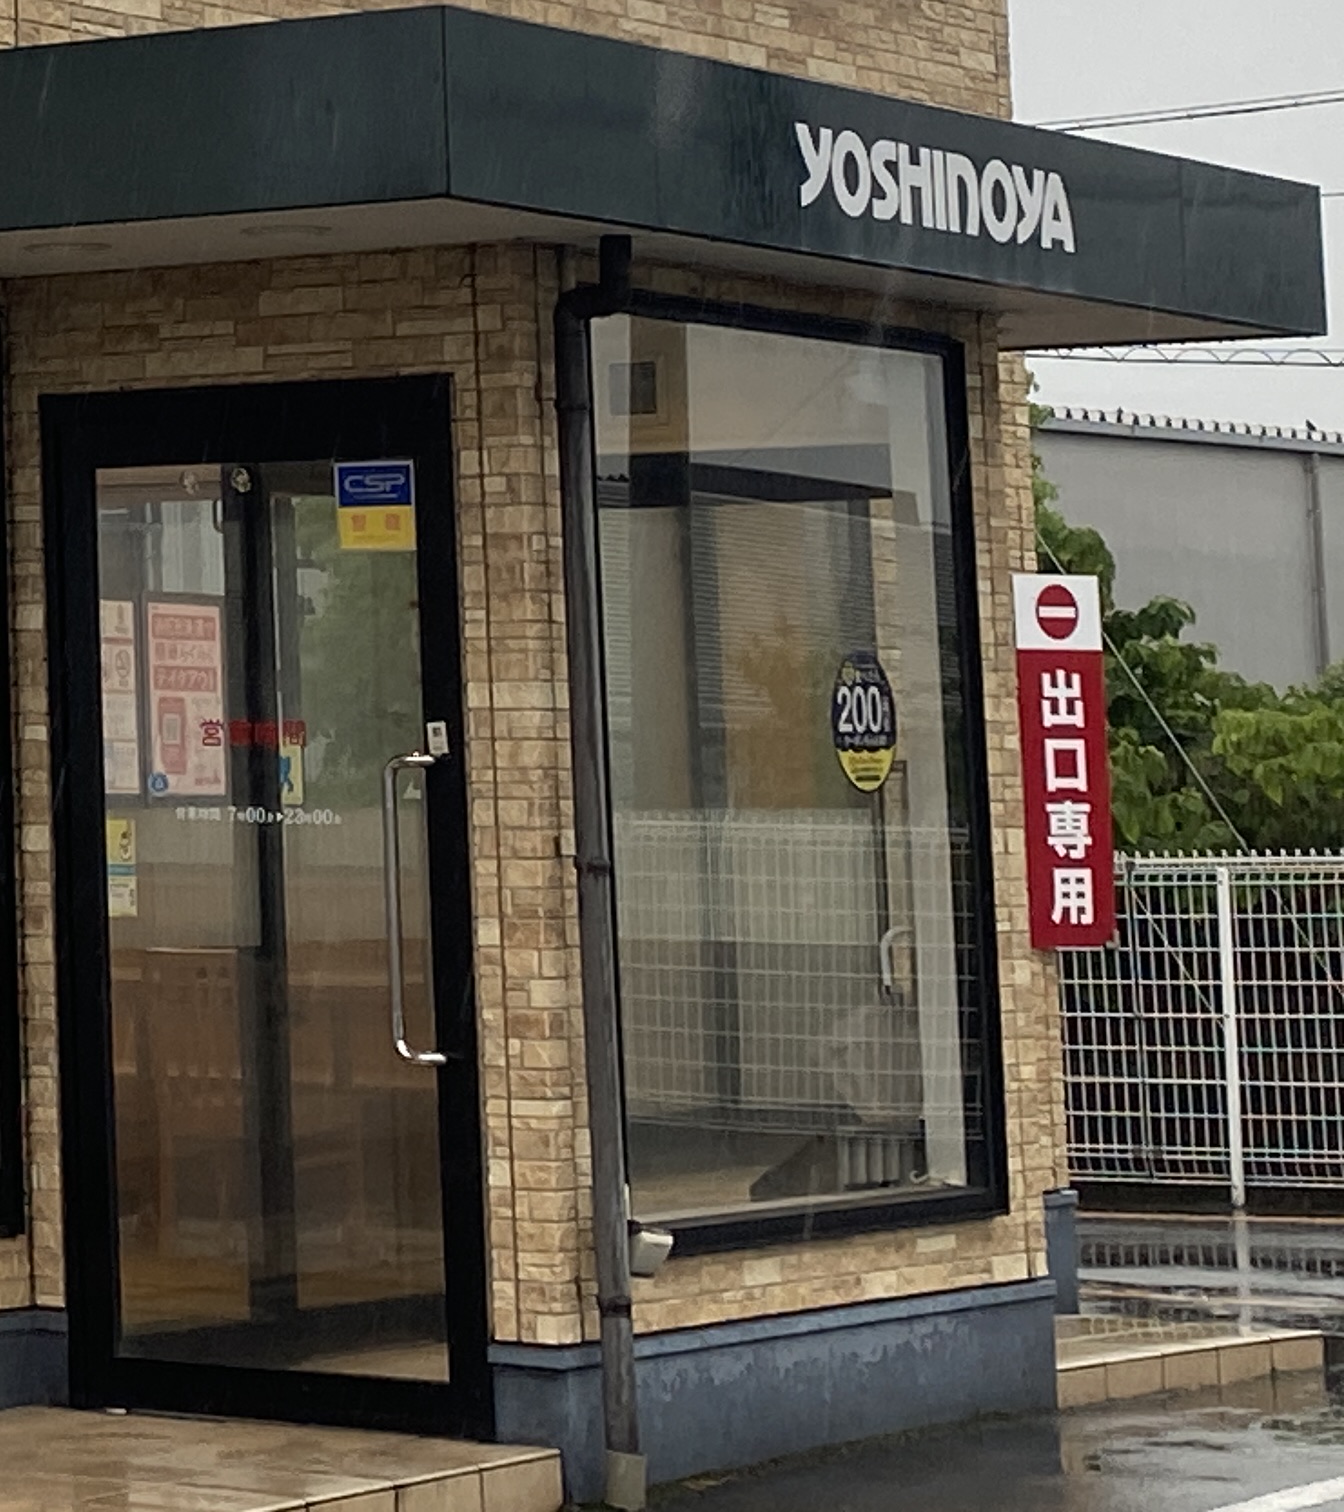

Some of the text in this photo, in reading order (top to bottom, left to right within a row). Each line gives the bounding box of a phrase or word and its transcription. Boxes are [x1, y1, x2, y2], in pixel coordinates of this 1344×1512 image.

[794, 122, 1076, 254] YOSHINOYA
[837, 685, 883, 734] 200
[1040, 669, 1095, 925] 出口専用
